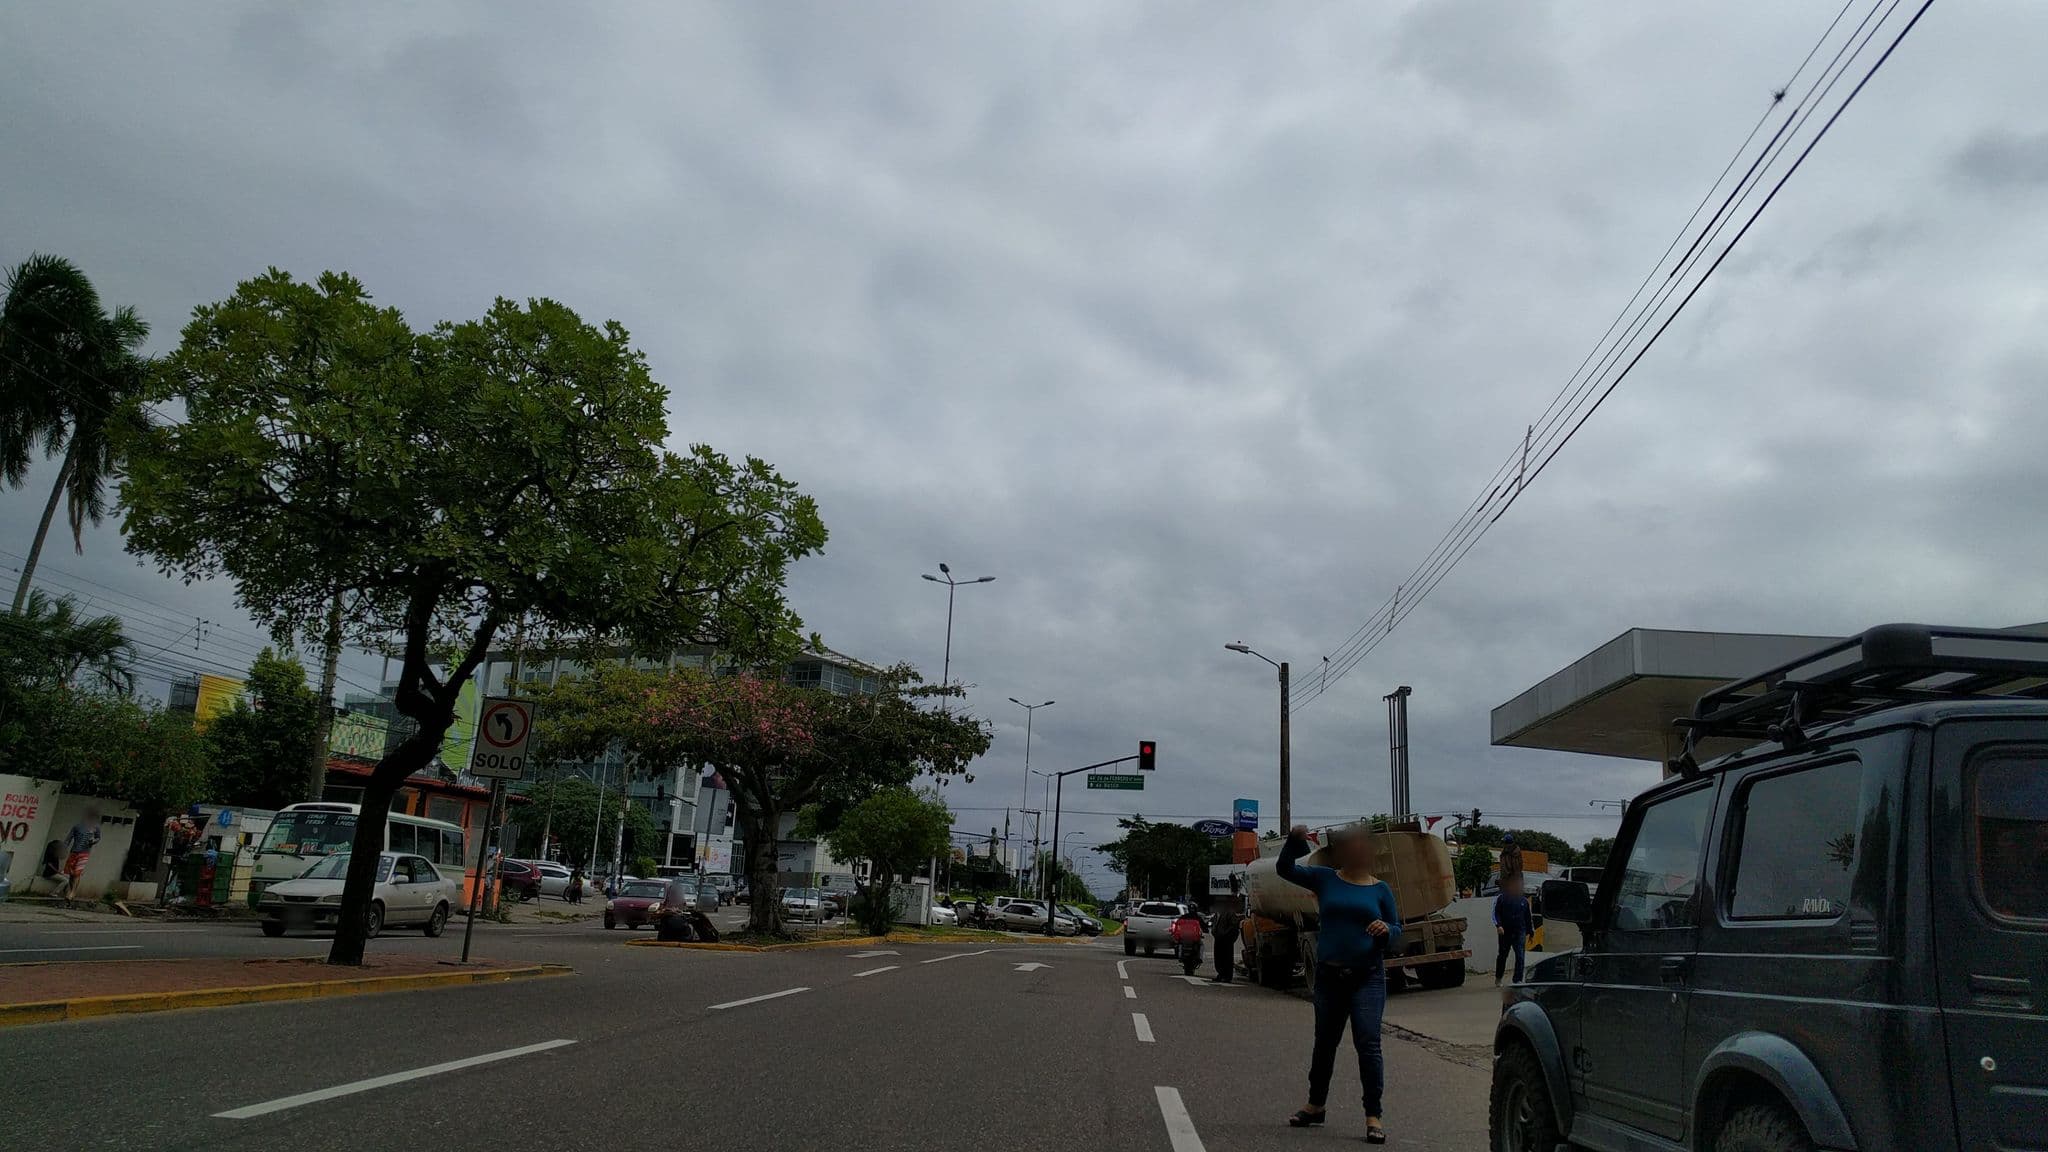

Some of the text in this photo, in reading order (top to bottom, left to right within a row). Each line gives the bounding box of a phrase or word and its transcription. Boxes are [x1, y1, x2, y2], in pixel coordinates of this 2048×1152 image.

[475, 753, 522, 770] SOLO
[5, 793, 40, 805] BOLIVIA
[0, 804, 38, 819] DICE
[0, 821, 29, 844] NO
[1201, 822, 1228, 834] Ford
